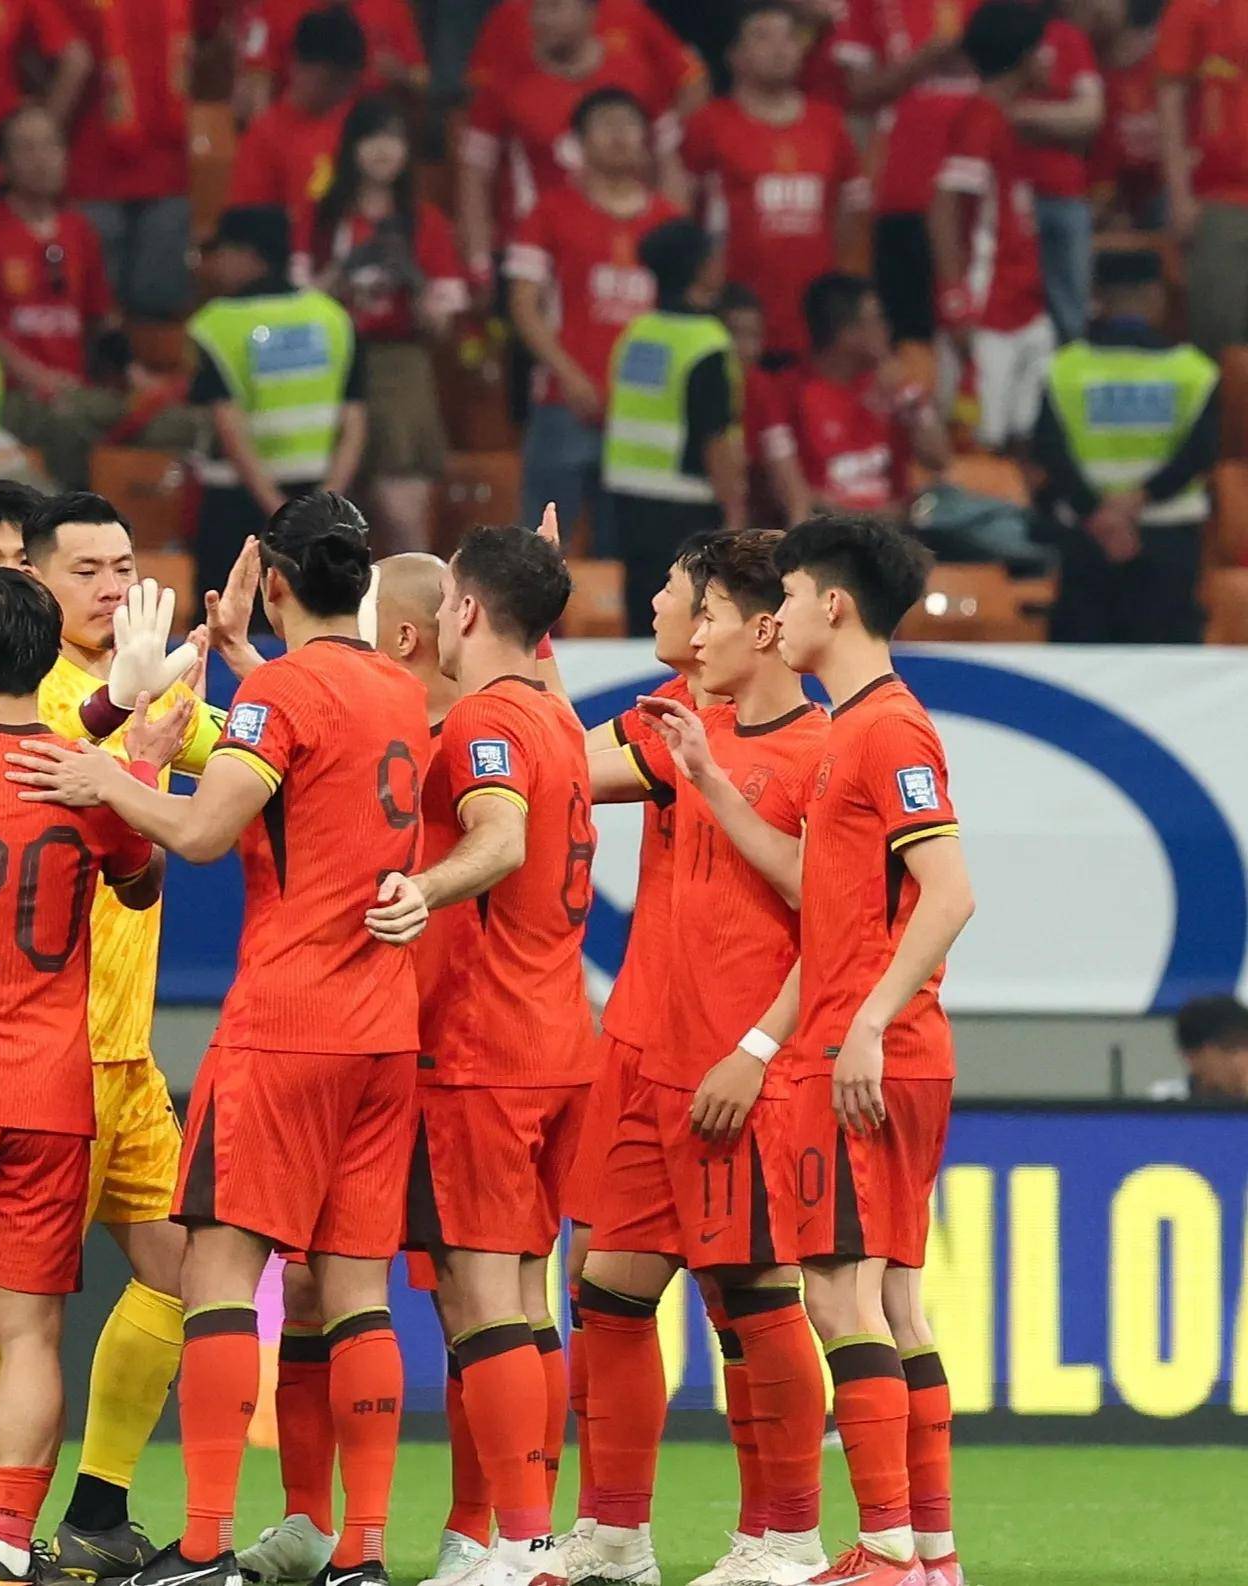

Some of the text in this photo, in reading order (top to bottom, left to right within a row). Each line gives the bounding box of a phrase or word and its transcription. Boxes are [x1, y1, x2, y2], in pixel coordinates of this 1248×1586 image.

[376, 741, 420, 887] 9
[561, 781, 594, 926] 8
[691, 821, 714, 884] 11
[700, 1155, 733, 1217] 11
[353, 1398, 397, 1415] 中国
